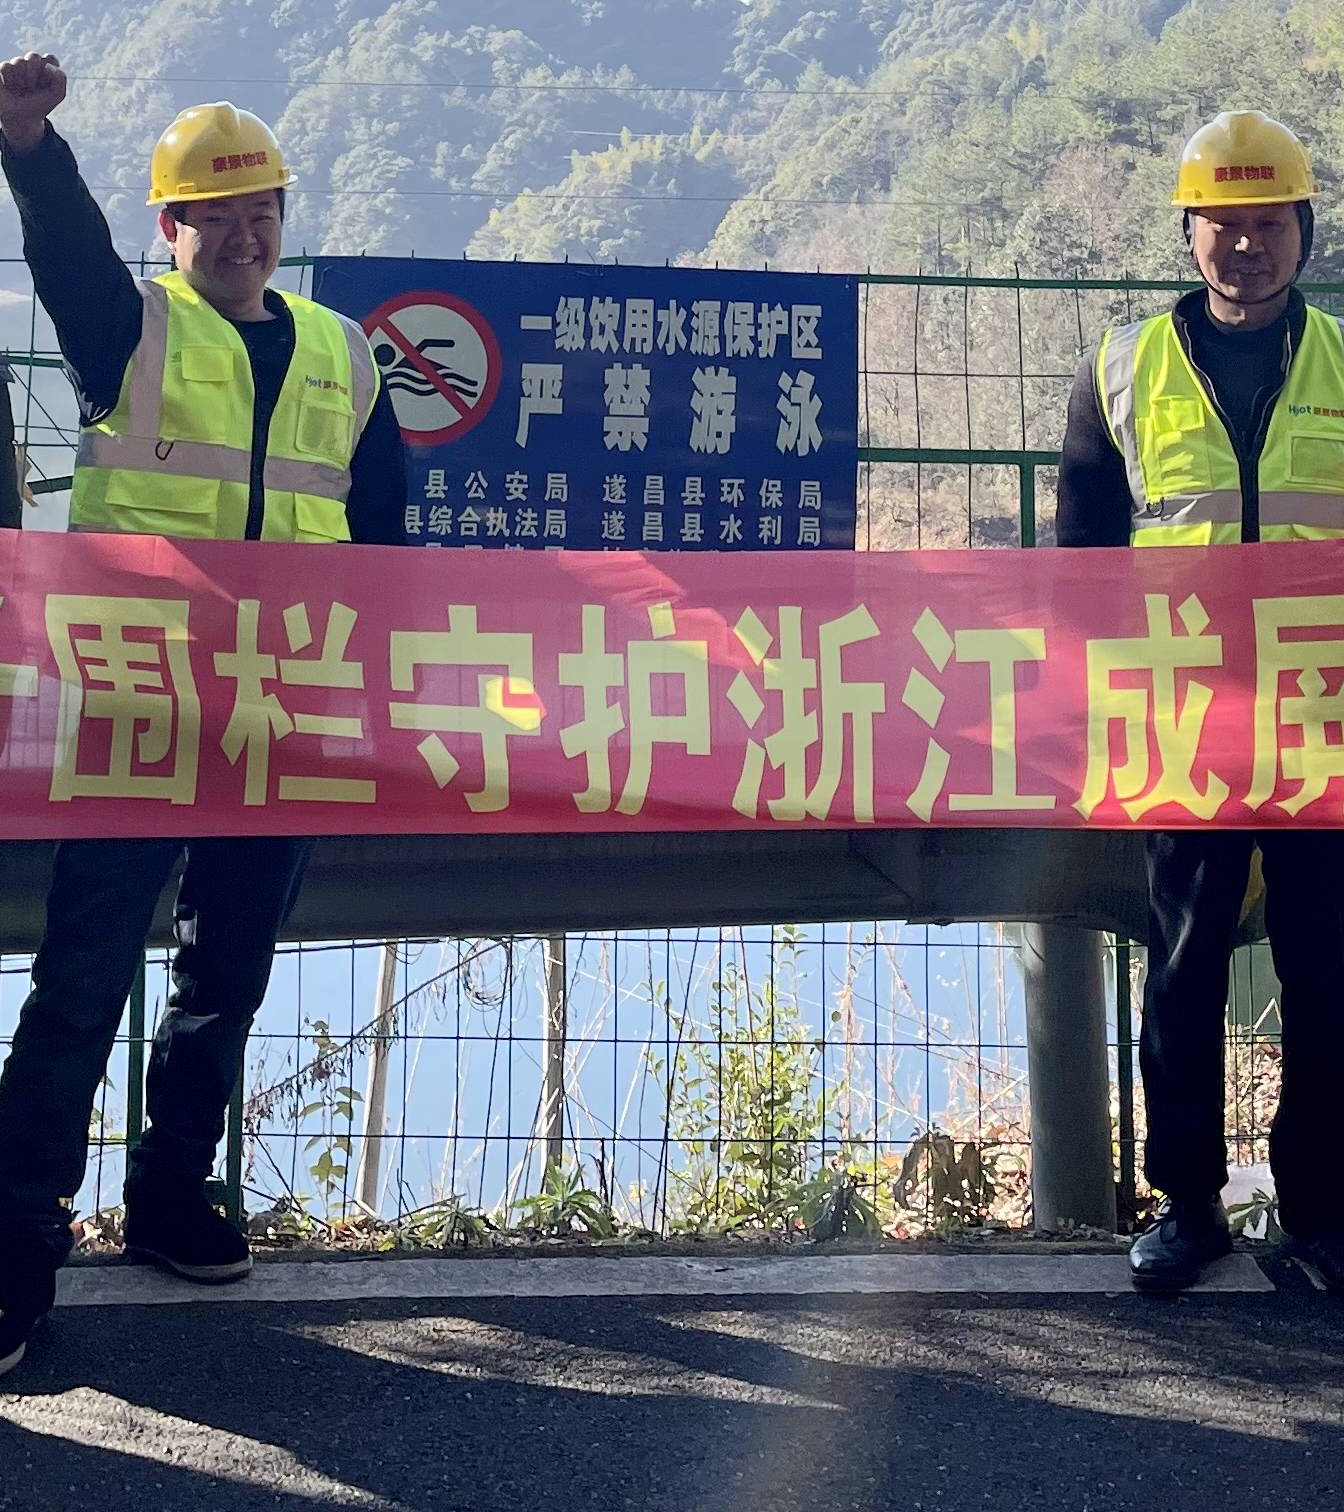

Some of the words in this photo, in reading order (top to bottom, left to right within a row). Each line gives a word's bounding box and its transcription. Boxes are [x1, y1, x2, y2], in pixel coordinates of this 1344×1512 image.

[519, 295, 823, 361] 一级饮用水源保护区
[514, 362, 824, 457] 严禁游泳
[423, 469, 569, 503] 县公安局
[602, 473, 823, 511] 遂昌县环保局
[405, 504, 568, 539] 县综合执法局
[601, 510, 822, 548] 遂昌县水利局
